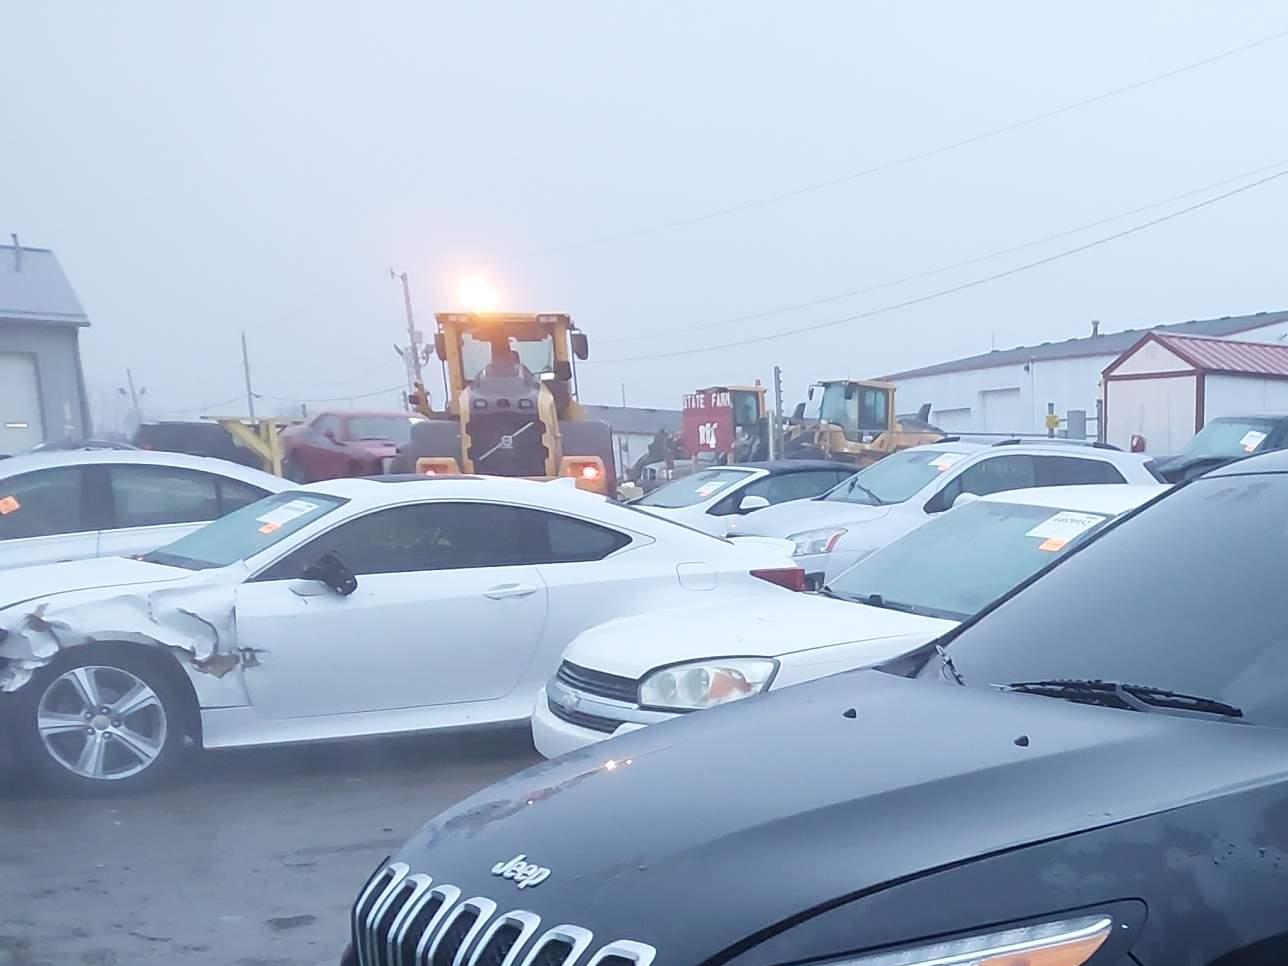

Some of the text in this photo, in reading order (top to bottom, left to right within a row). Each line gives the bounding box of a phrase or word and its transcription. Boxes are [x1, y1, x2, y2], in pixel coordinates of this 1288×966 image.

[682, 392, 731, 409] STATE FARM
[491, 853, 552, 889] Jeep
